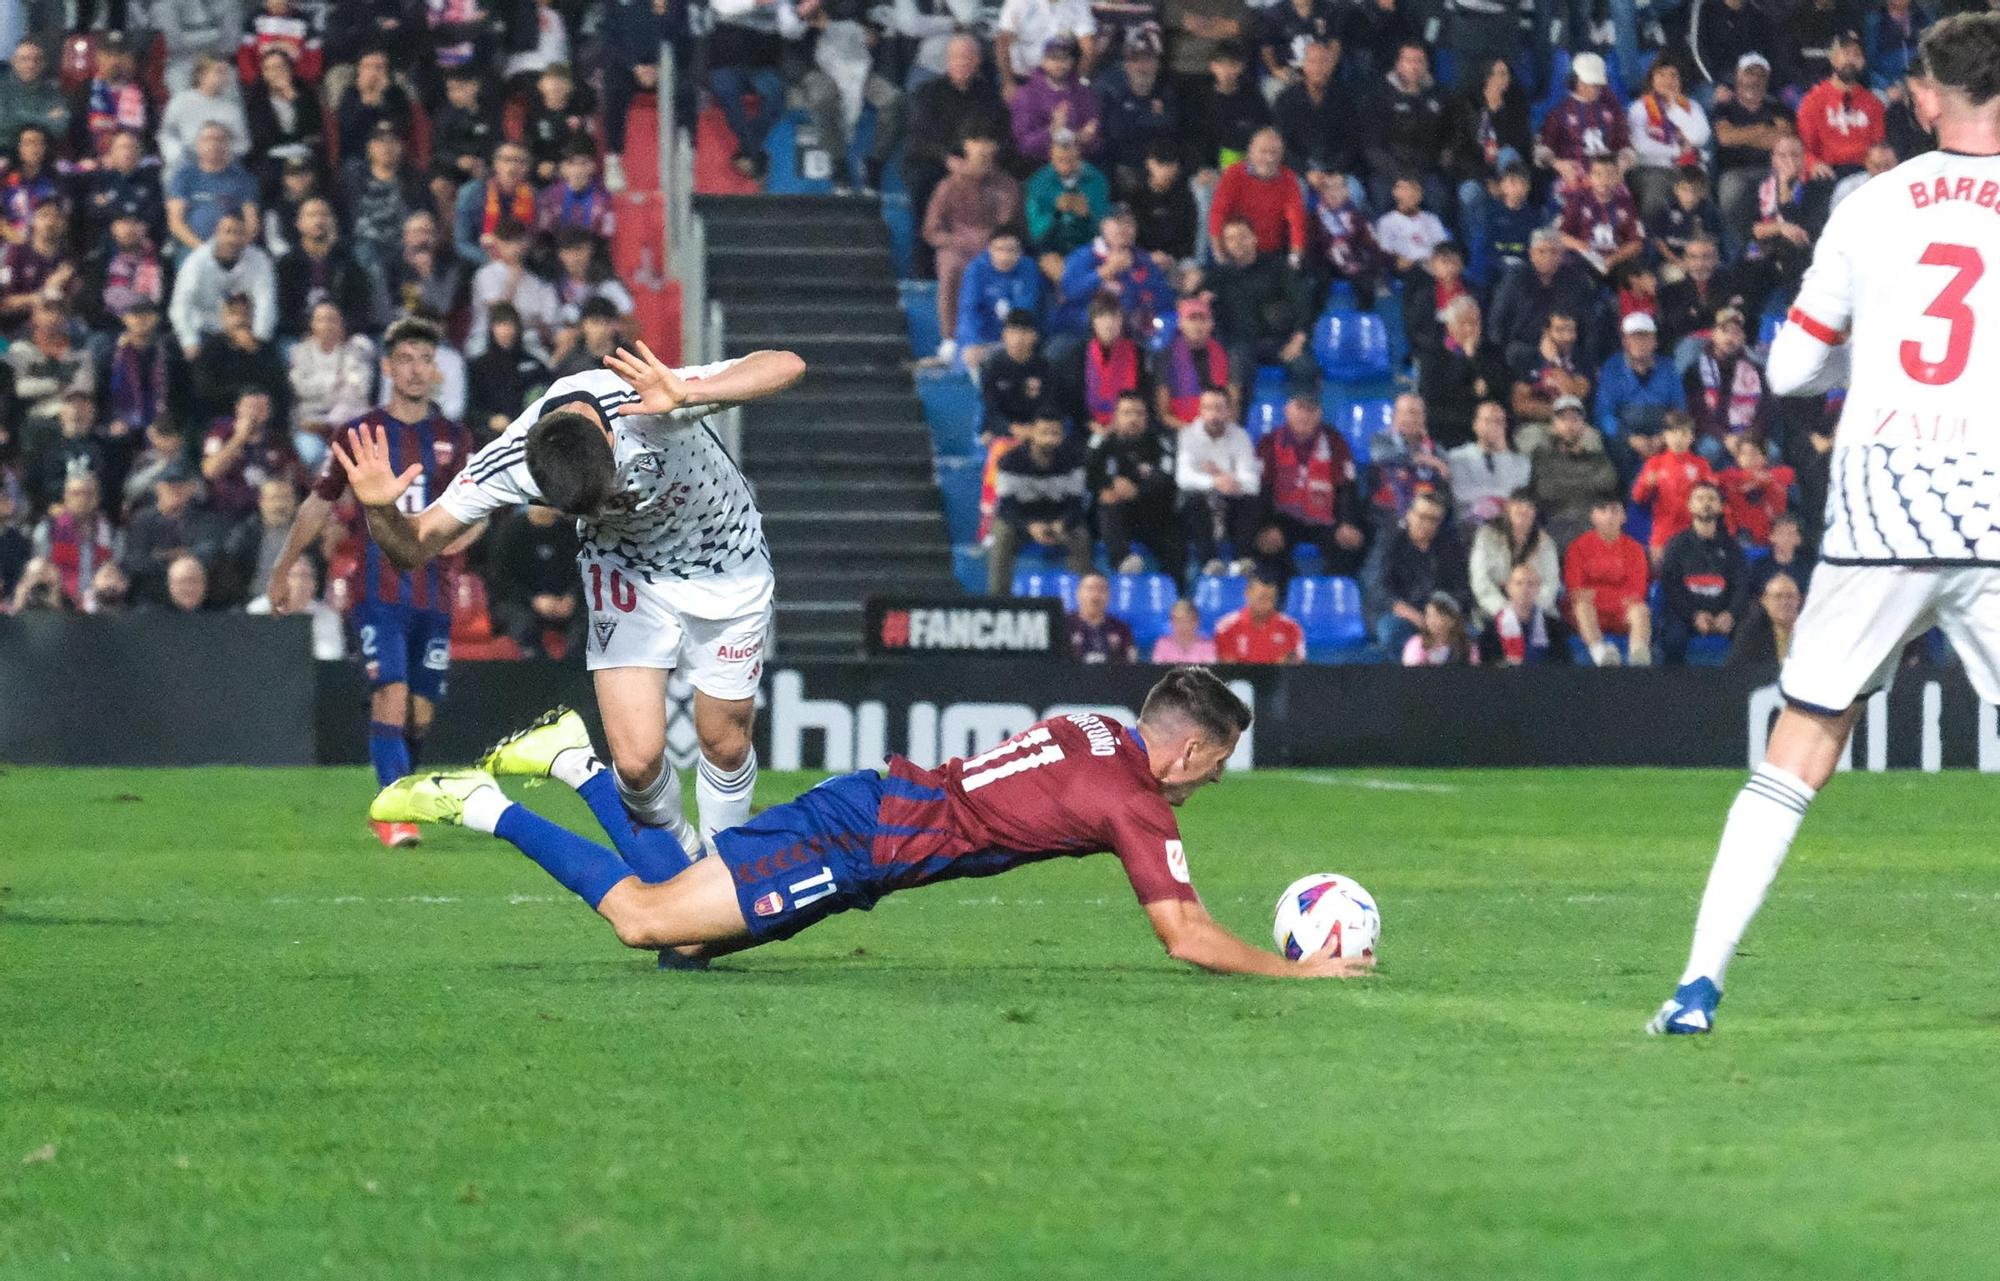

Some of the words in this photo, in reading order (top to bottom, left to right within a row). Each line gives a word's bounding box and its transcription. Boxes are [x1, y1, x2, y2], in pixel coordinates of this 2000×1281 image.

[1909, 177, 2000, 215] BARB
[1899, 242, 1985, 385] 3
[588, 563, 637, 613] 10
[361, 625, 377, 656] 2
[881, 608, 1049, 649] #FANCAM
[1066, 712, 1121, 757] ORTUÑO
[961, 726, 1066, 793] 11
[789, 866, 837, 909] 11
